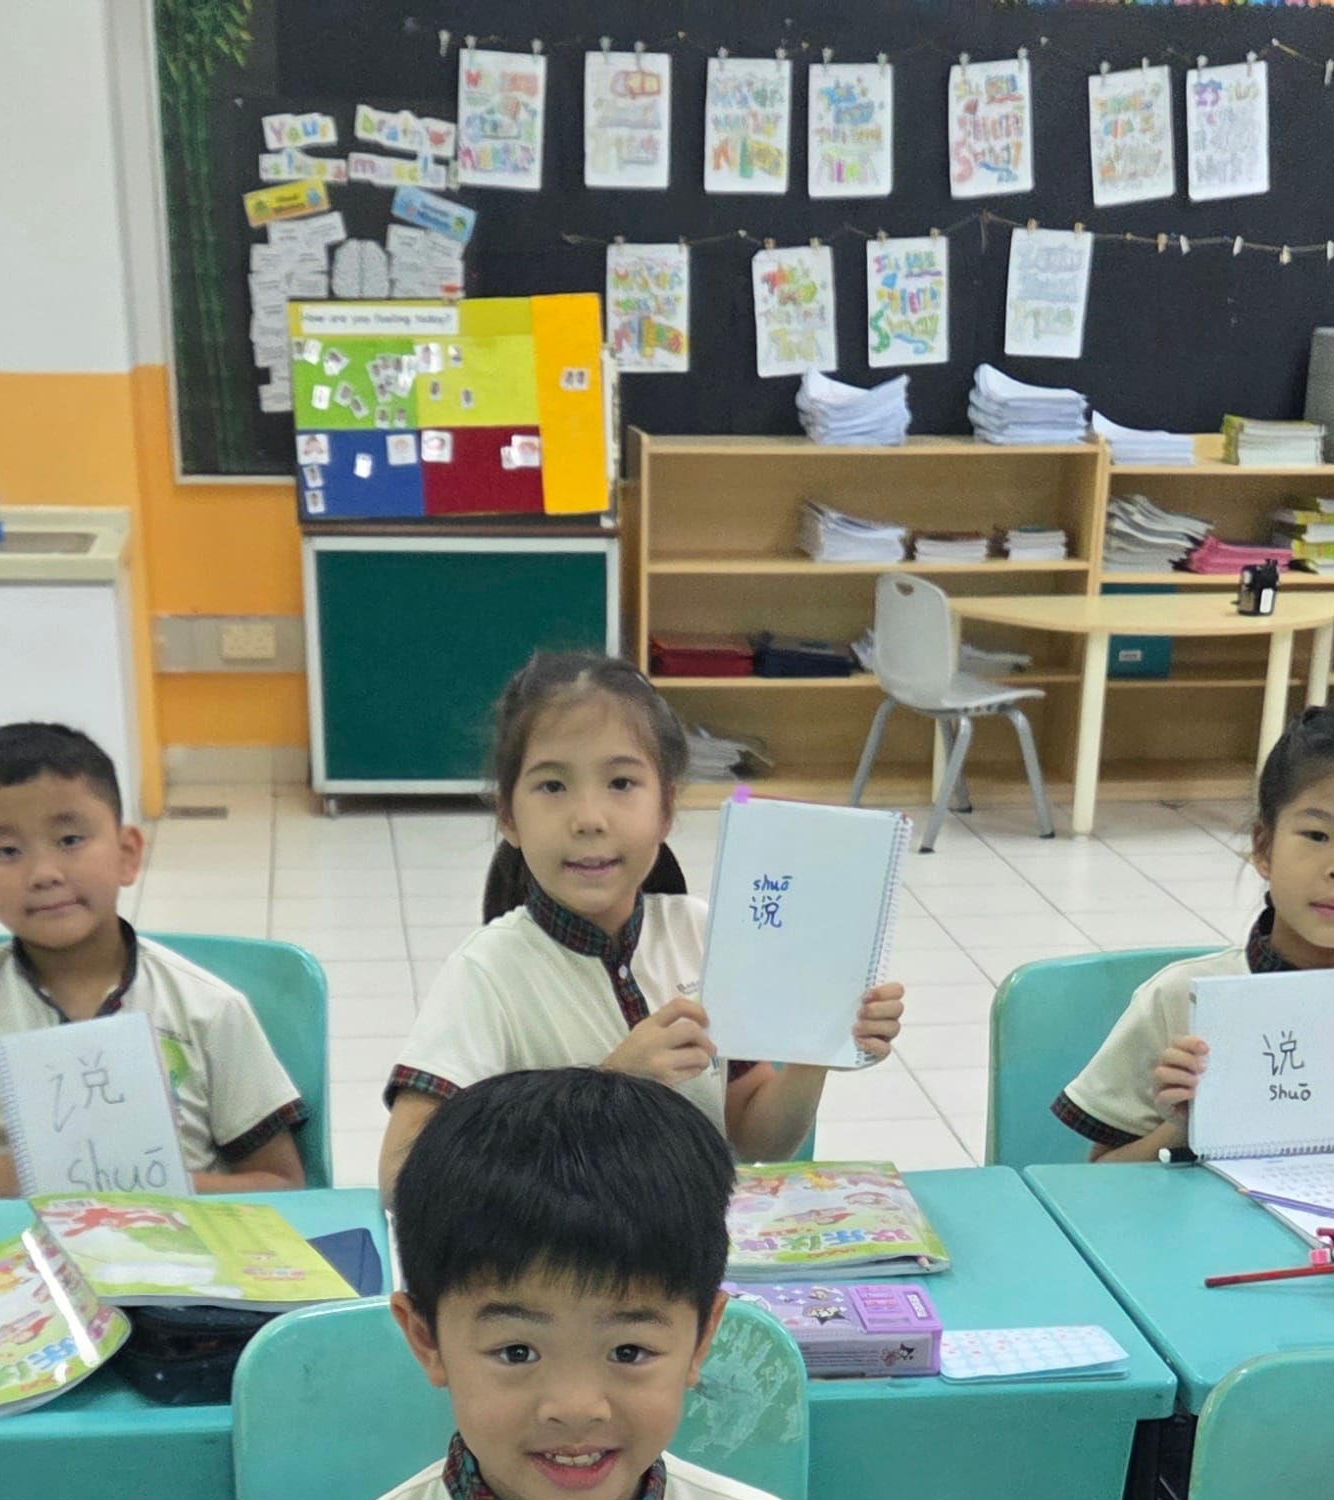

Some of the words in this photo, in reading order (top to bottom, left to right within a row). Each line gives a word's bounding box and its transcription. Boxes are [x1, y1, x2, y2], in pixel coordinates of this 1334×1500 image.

[752, 873, 793, 892] shuō
[749, 894, 783, 931] 说
[1262, 1030, 1305, 1077] 说
[45, 1051, 125, 1134] 说
[67, 1138, 168, 1192] shuō
